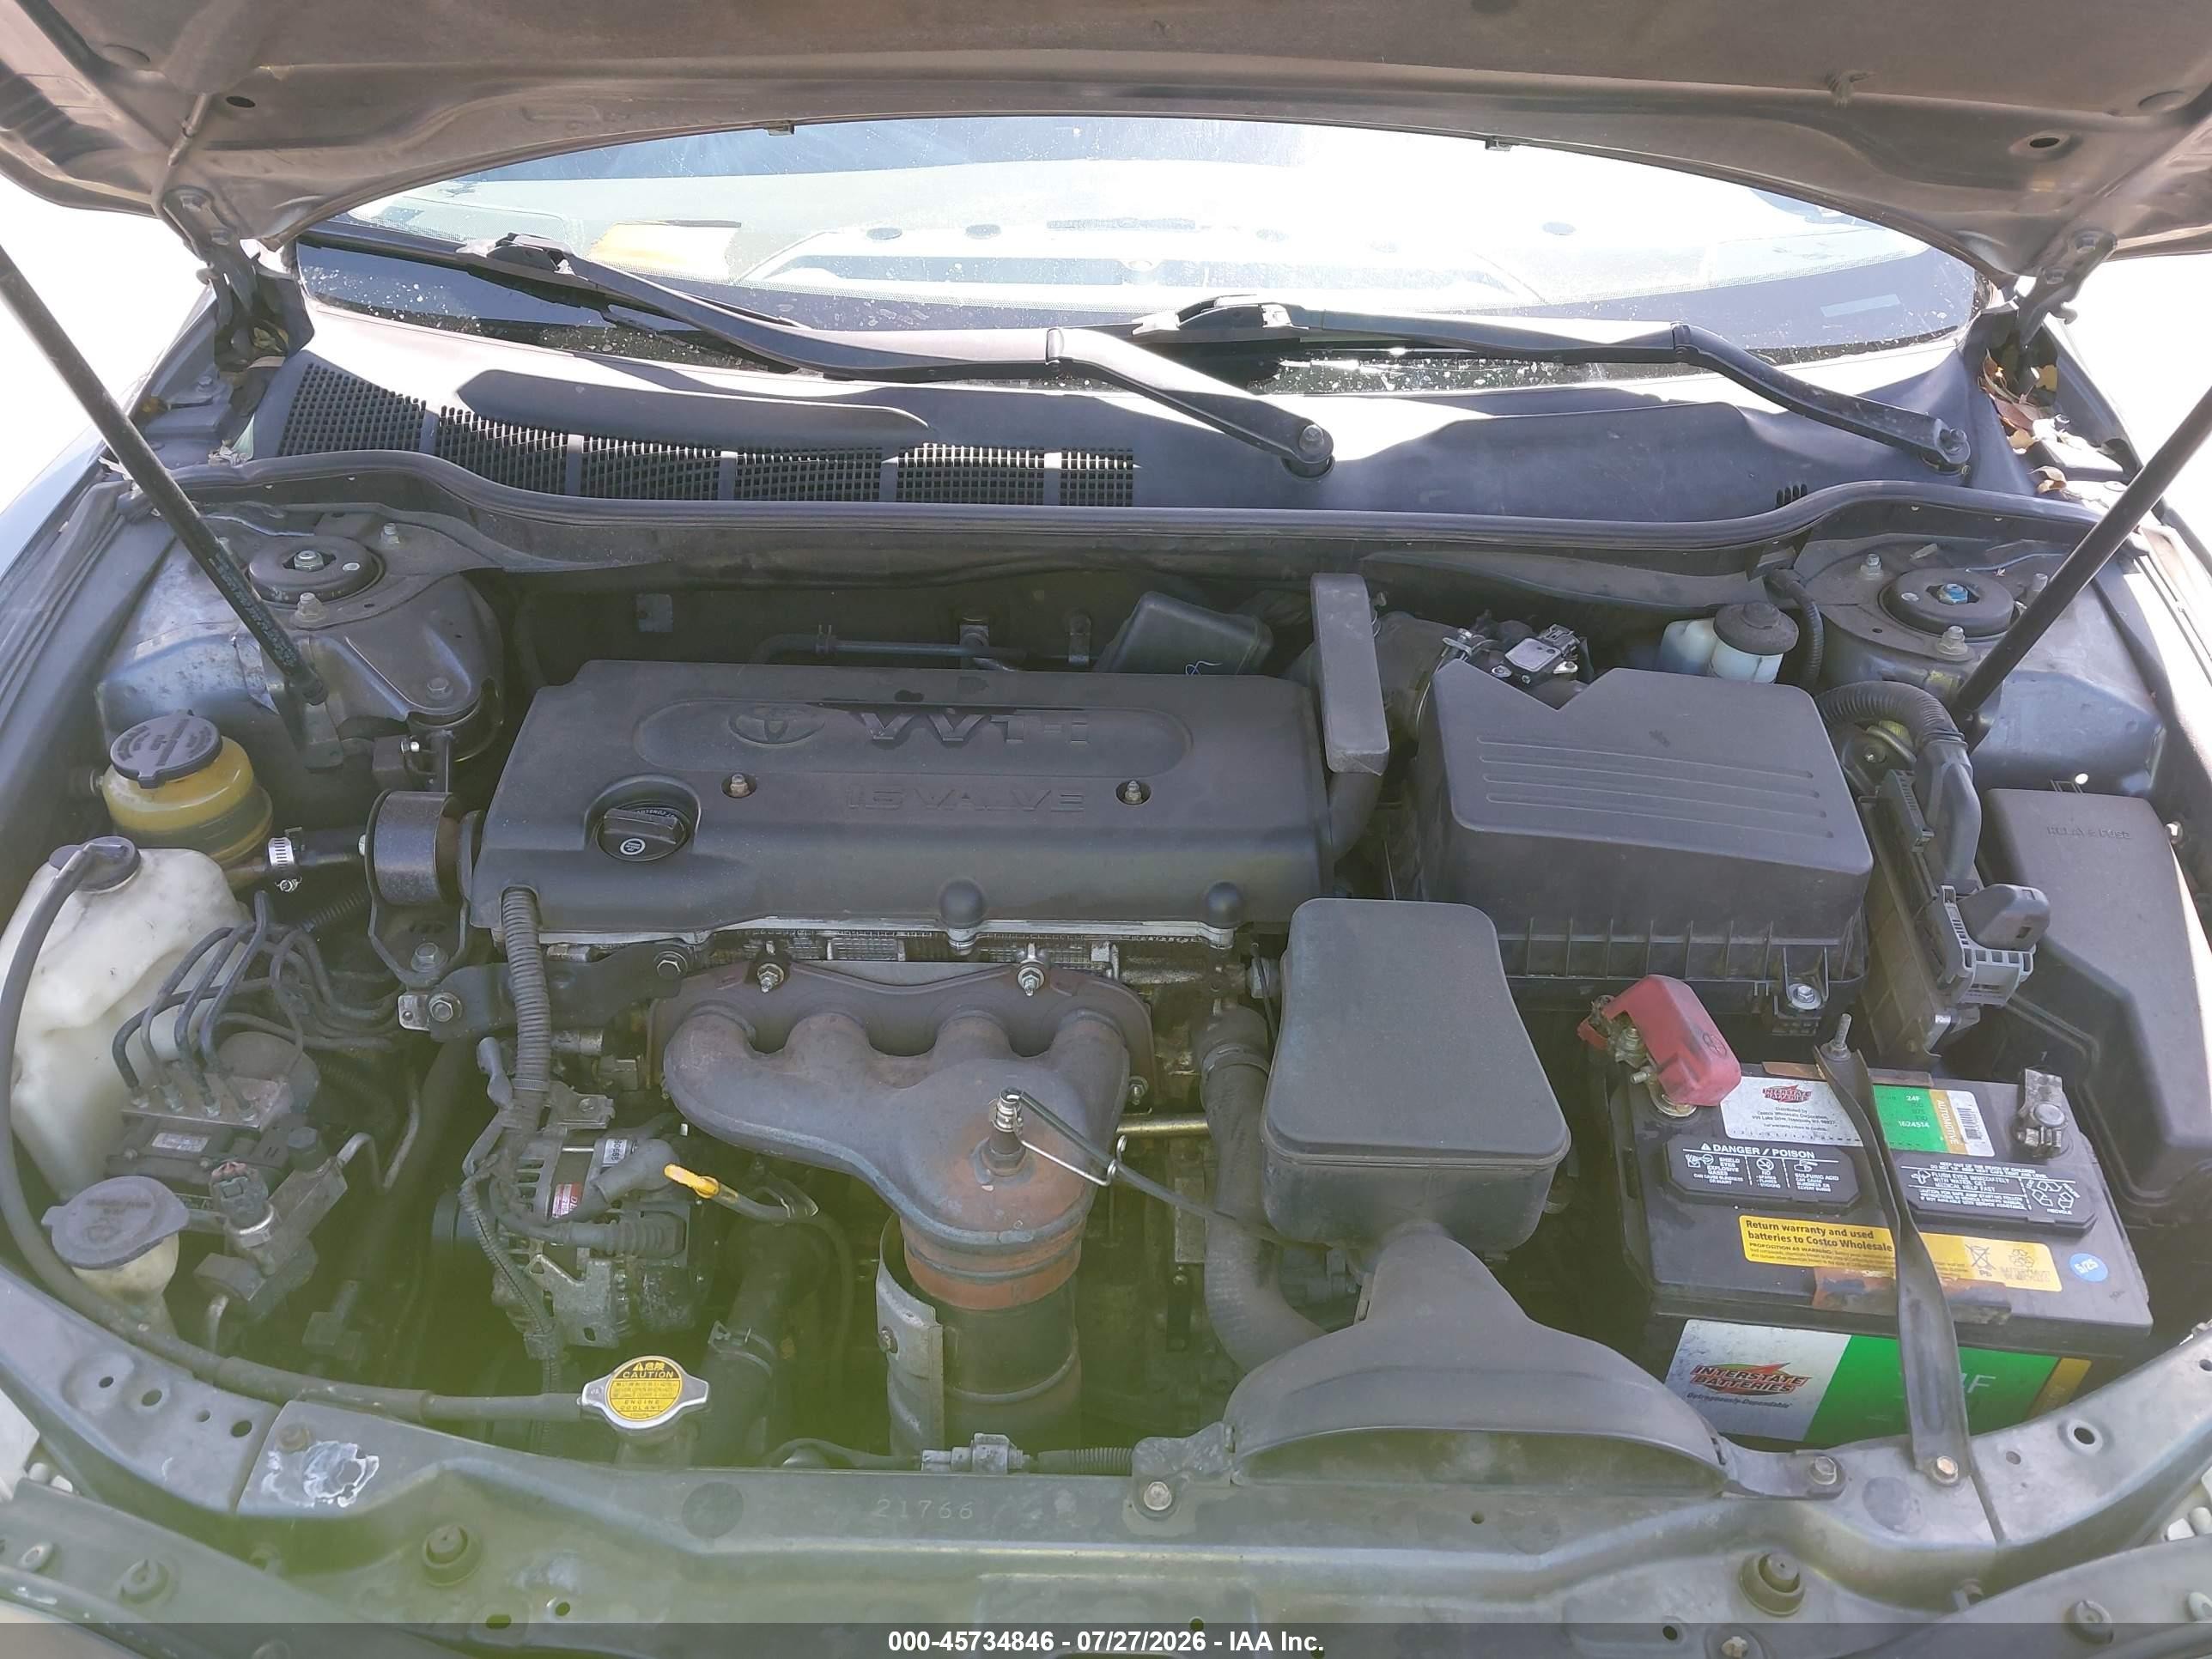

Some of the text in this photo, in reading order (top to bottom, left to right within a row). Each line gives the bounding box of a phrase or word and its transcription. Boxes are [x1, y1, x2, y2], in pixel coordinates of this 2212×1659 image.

[2098, 829, 2132, 840] FUSE
[1762, 1088, 1812, 1097] INTERSTATE
[1764, 1092, 1809, 1101] BATTERIES
[1936, 1100, 1959, 1145] AUTOMOTIVE
[1713, 1144, 1760, 1155] DANGER
[1771, 1148, 1815, 1158] POISON
[1970, 1175, 2009, 1183] IMMEDIATELY
[1746, 1220, 1779, 1231] Return
[1781, 1224, 1826, 1237] warranty
[1850, 1231, 1875, 1239] used
[1747, 1231, 1791, 1243] batteries
[1806, 1236, 1838, 1247] Costco
[1839, 1239, 1893, 1252] Wholesale
[1691, 1364, 1808, 1386] INTERSTATE
[1691, 1375, 1796, 1393] BATTERIES
[875, 1498, 975, 1520] 21766
